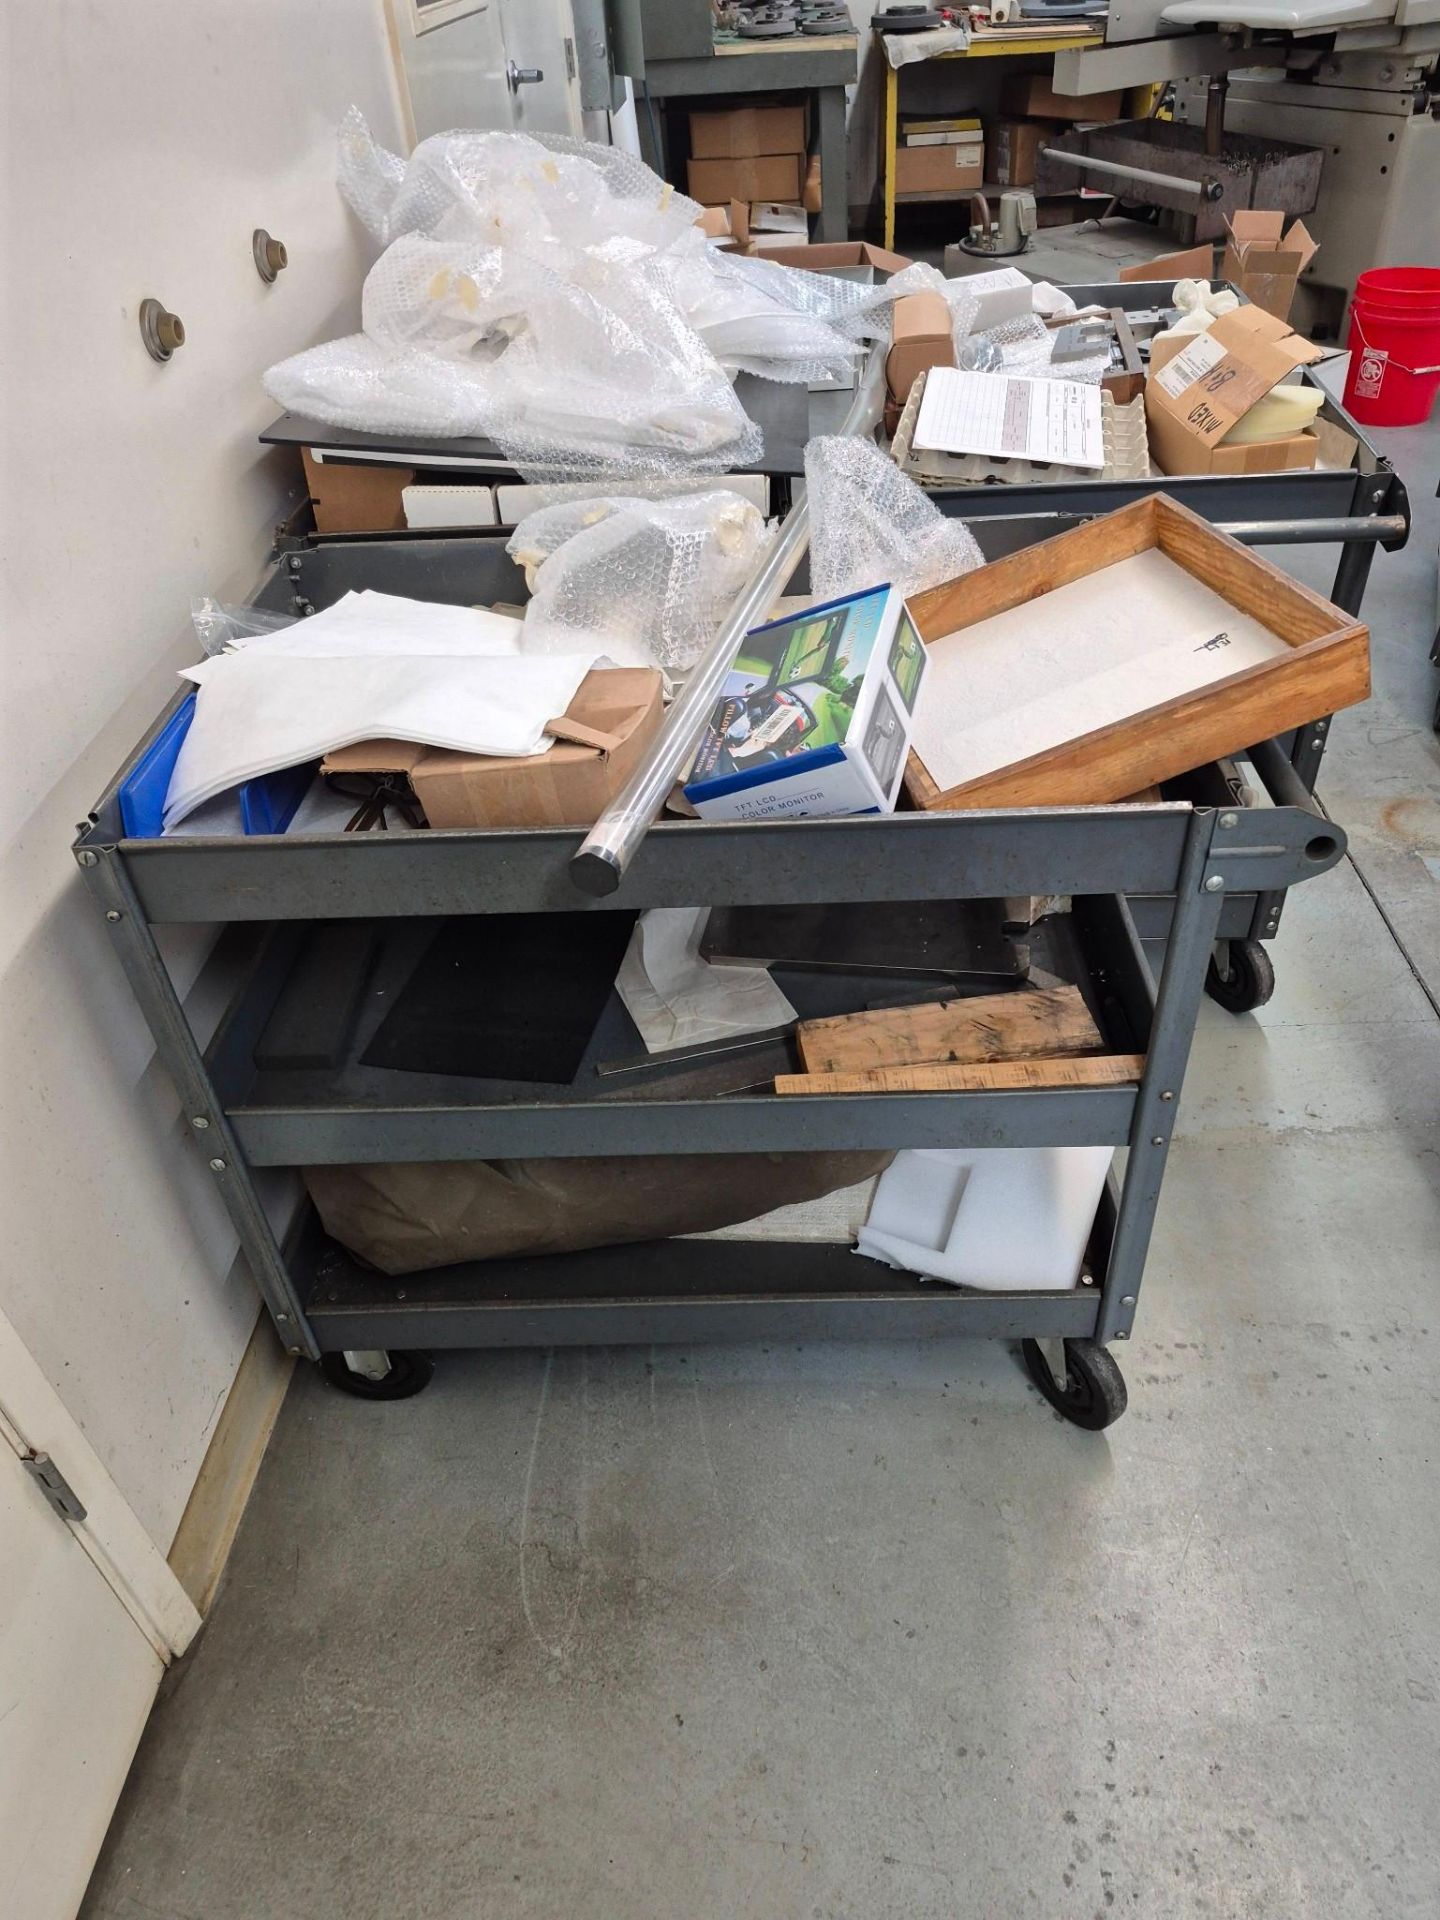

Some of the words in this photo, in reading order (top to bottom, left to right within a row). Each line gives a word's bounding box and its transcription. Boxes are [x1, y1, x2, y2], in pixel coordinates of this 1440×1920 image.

[1187, 402, 1224, 434] MIXED
[734, 801, 753, 813] TFT
[756, 795, 776, 807] LCD
[742, 806, 775, 820] COLOR
[778, 792, 825, 810] MONITOR
